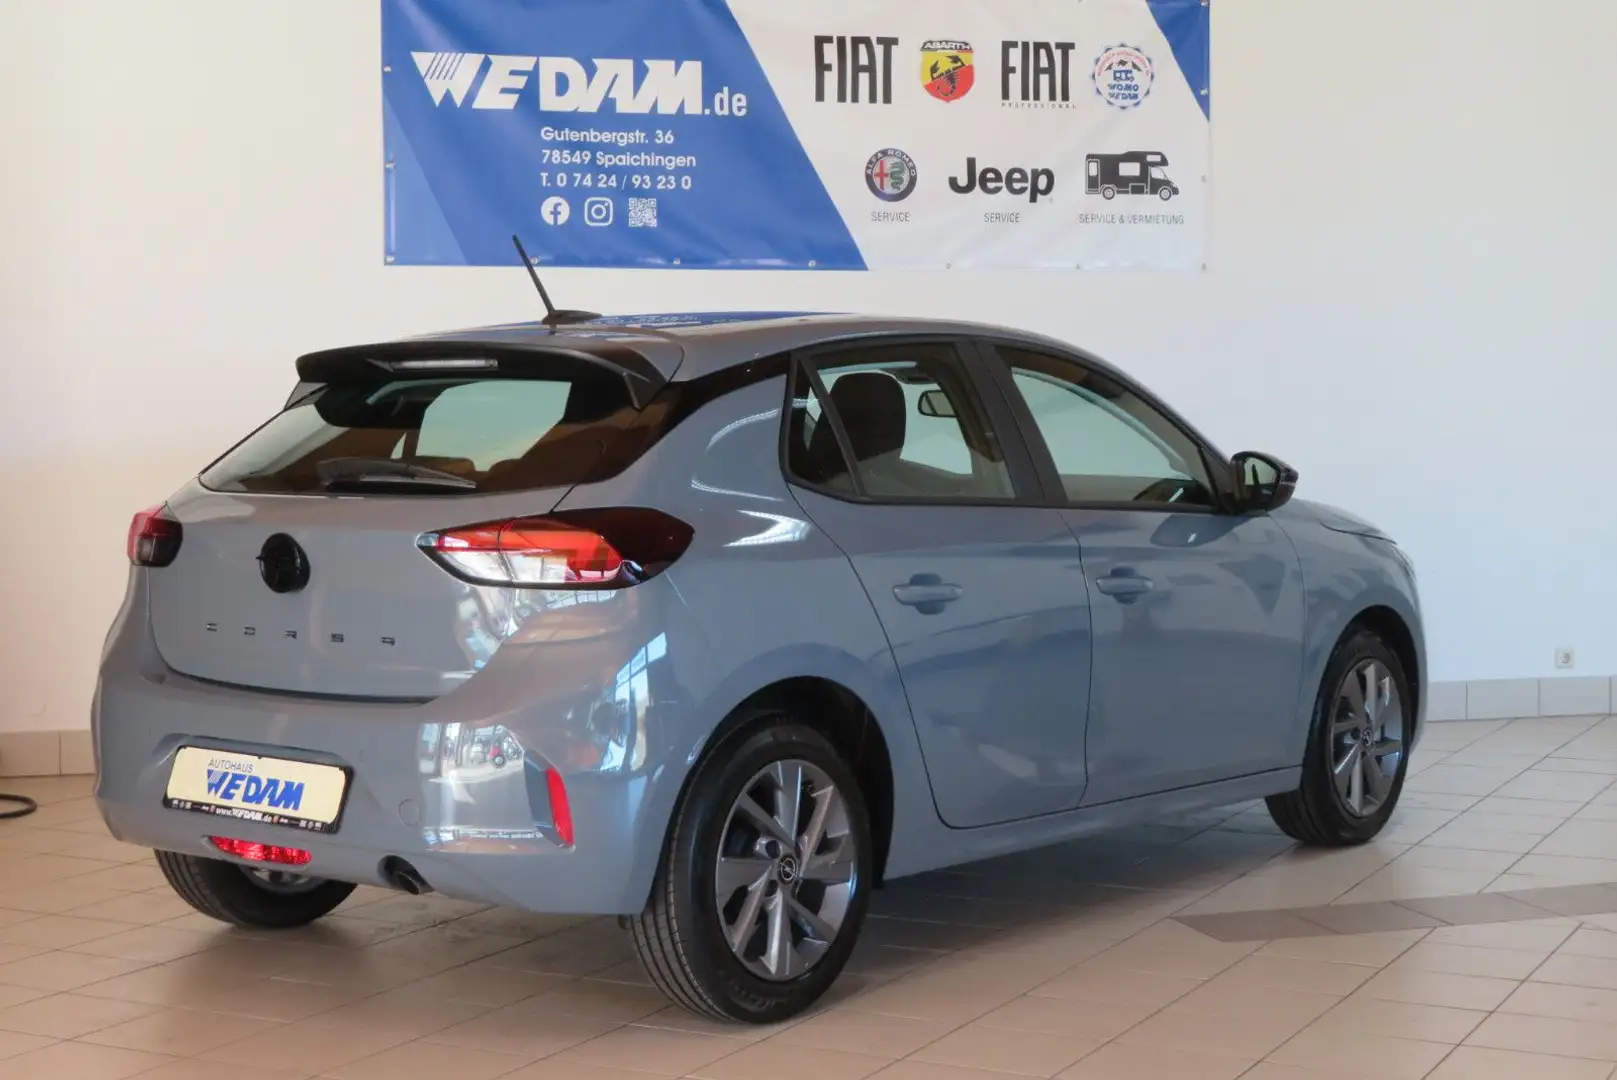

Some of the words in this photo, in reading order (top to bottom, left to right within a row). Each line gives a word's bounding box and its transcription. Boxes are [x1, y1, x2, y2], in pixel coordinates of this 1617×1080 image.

[924, 41, 971, 50] ABARTH
[814, 35, 899, 104] FIAT
[1001, 40, 1076, 102] FIAT
[411, 51, 747, 117] WEDAM.de
[540, 126, 649, 146] Gutenbergstr.
[654, 130, 675, 144] 36
[541, 149, 592, 164] 78549
[596, 151, 697, 170] Spaichingen
[866, 152, 884, 175] ALFA
[887, 149, 917, 177] ROMEO
[540, 172, 551, 187] T.
[556, 173, 568, 187] 0
[573, 173, 593, 187] 74
[597, 174, 617, 188] 24
[631, 175, 652, 189] 93
[656, 175, 676, 190] 23
[681, 176, 692, 190] 0
[949, 157, 1055, 203] Jeep
[871, 211, 911, 222] SERVICE
[984, 212, 1020, 223] SERVICE
[1079, 213, 1116, 224] SERVICE
[1118, 214, 1125, 224] &
[1127, 214, 1184, 225] VERMIETUNG
[208, 758, 254, 773] AUTOHAUS
[207, 768, 305, 811] WEDAM
